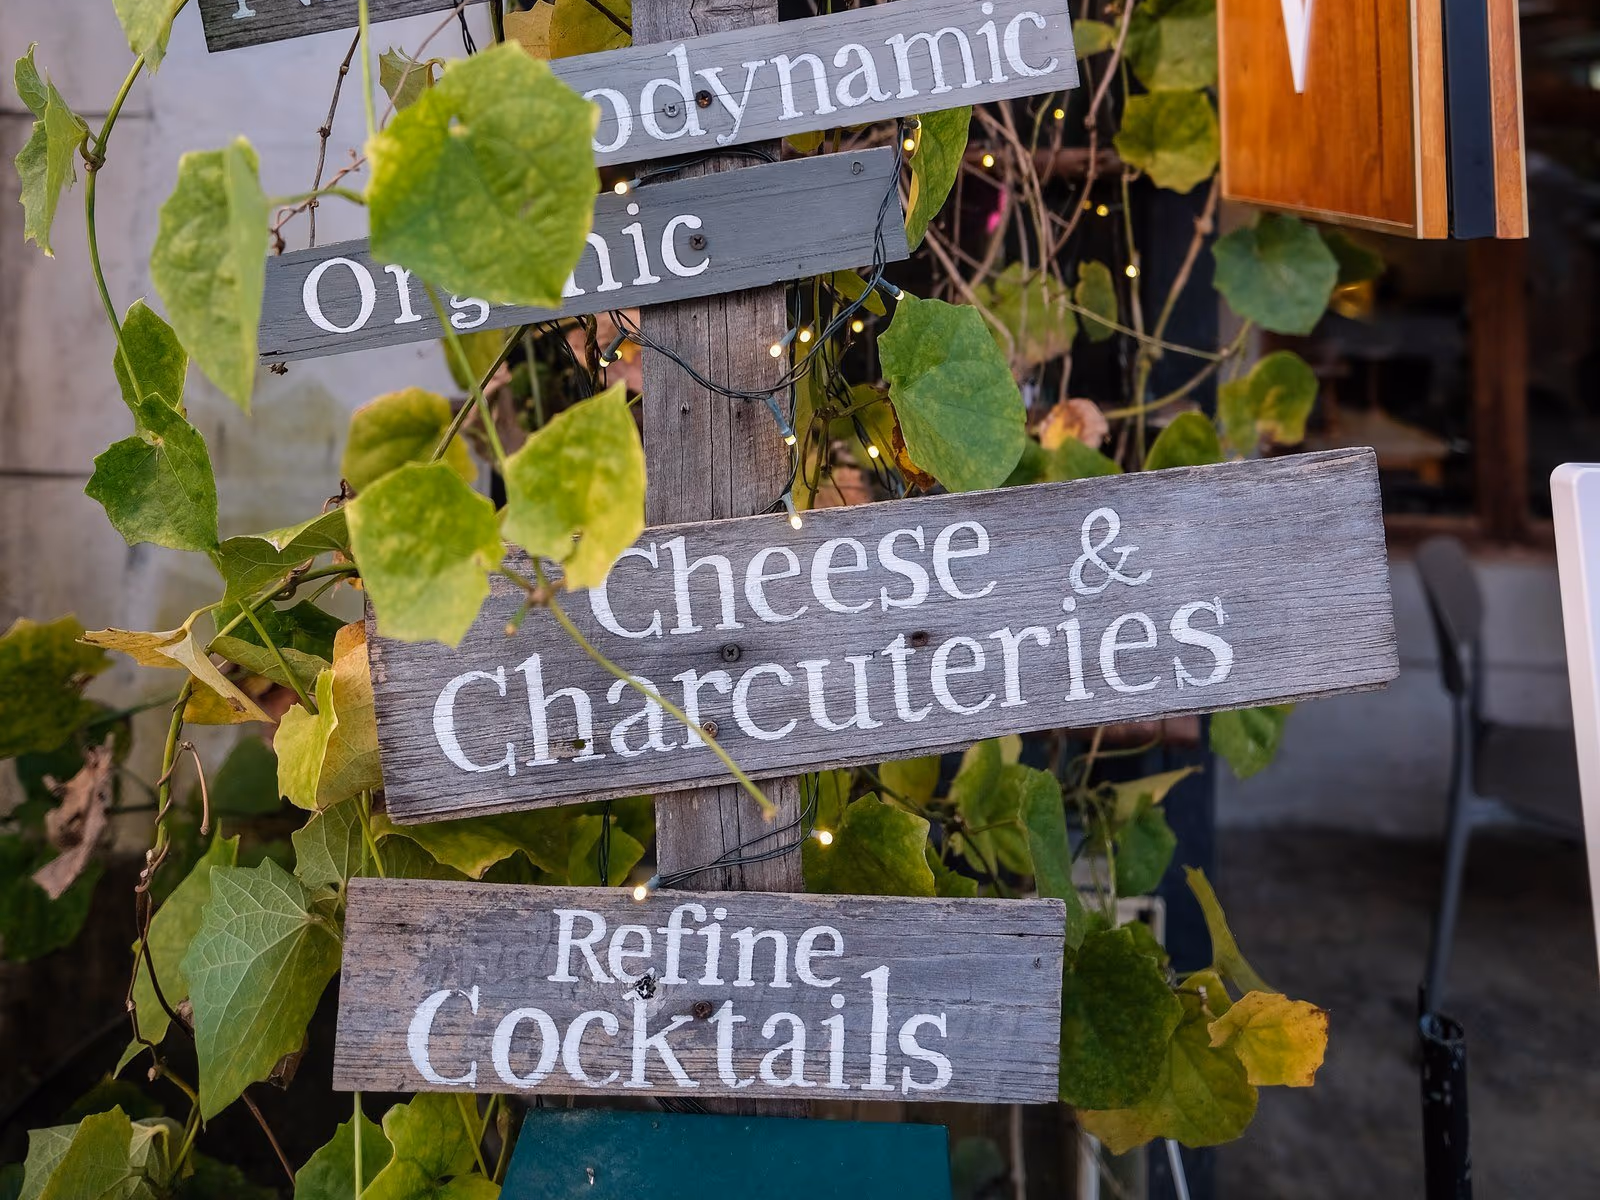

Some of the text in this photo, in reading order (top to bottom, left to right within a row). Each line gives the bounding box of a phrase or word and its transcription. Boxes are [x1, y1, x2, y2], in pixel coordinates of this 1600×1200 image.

[583, 1, 1059, 153] odynamic
[588, 507, 1153, 639] Cheese &
[433, 596, 1233, 777] Charcuteries
[547, 903, 844, 989] Refine
[407, 965, 955, 1096] Cocktails
